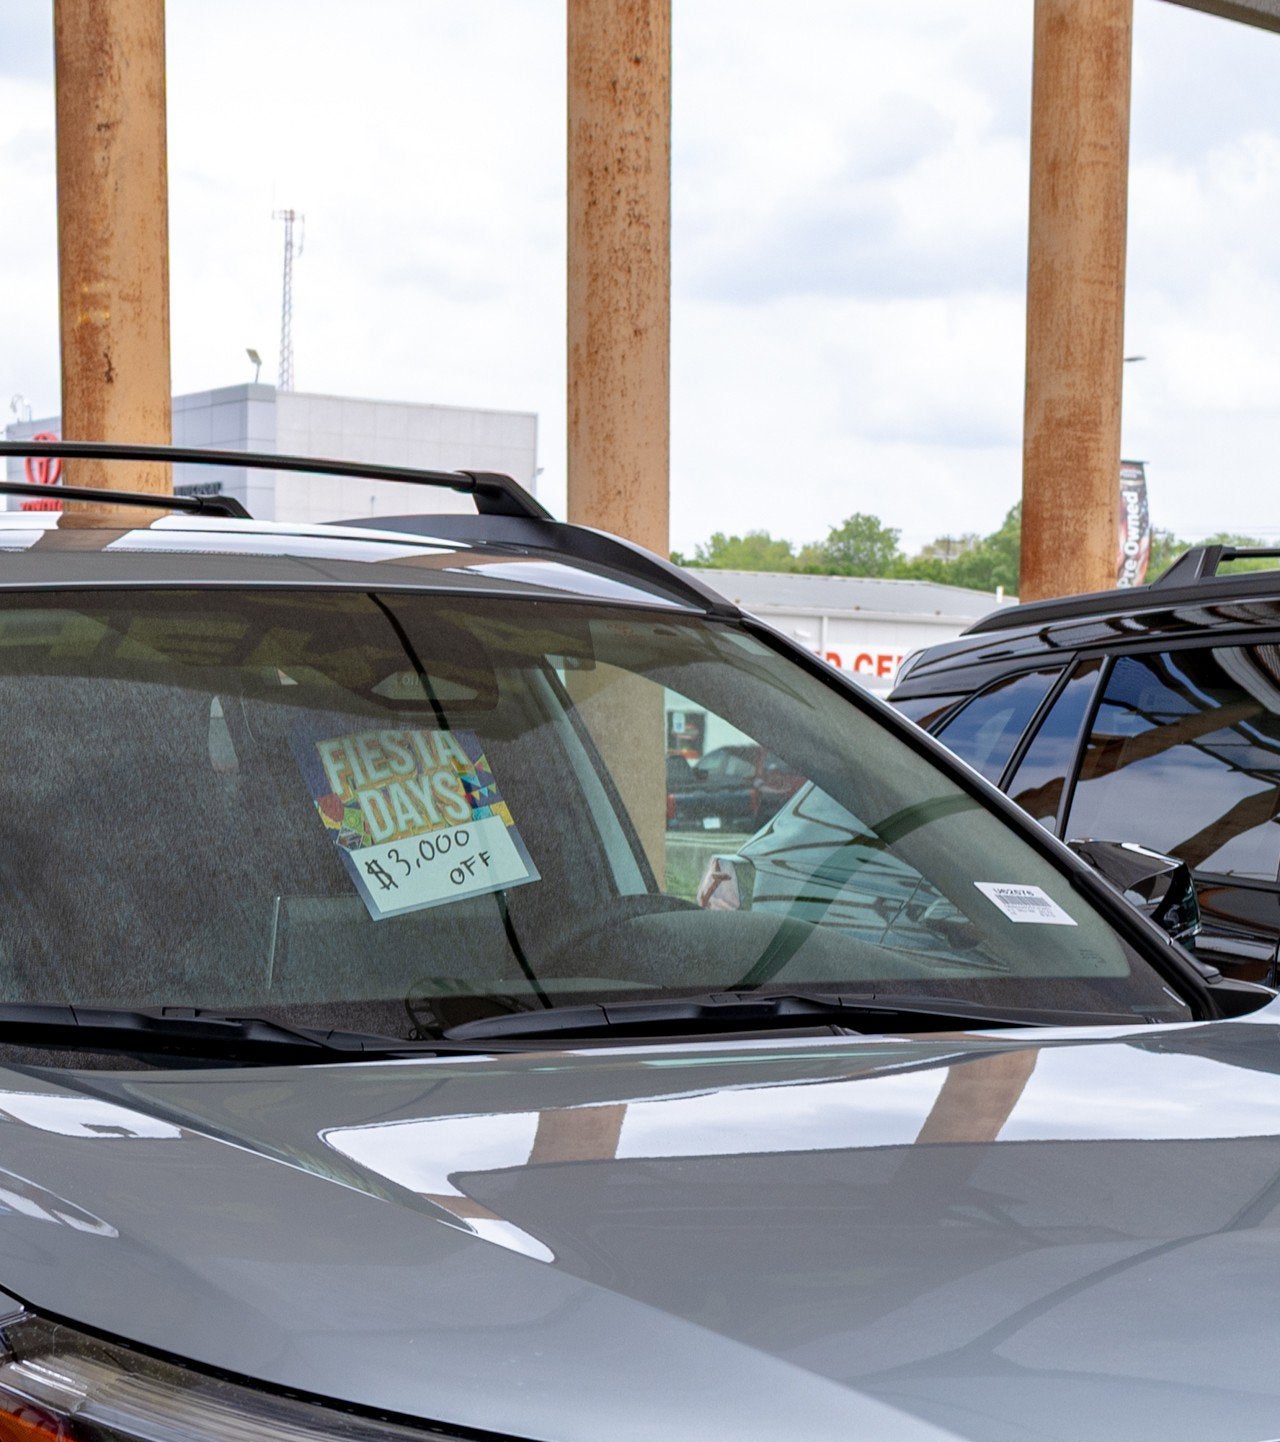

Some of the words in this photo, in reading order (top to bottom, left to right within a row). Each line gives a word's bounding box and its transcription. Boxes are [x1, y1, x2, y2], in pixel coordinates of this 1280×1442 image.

[1122, 490, 1140, 557] Owned
[320, 730, 470, 796] FIESTA
[357, 770, 471, 842] DAYS
[364, 830, 470, 890] $3,000
[450, 850, 492, 885] OFF
